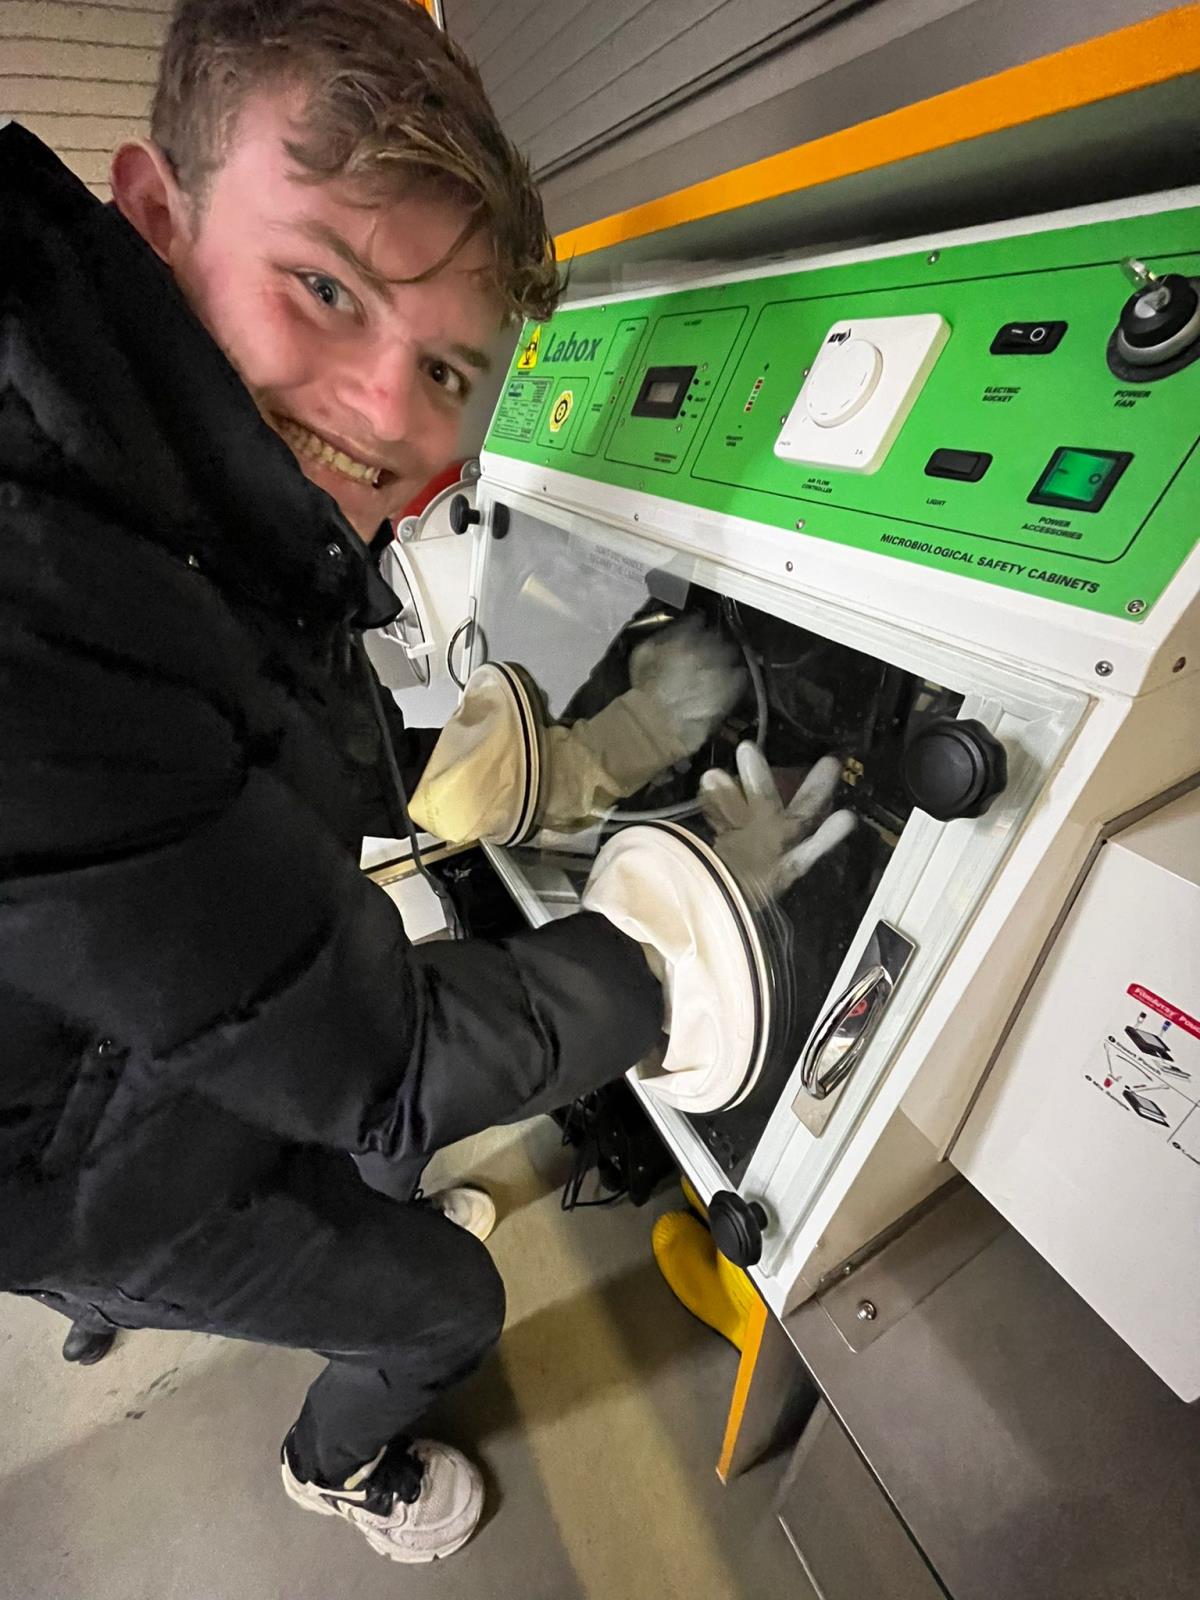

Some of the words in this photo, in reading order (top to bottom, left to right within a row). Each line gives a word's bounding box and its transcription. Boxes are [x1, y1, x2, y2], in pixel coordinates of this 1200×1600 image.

[542, 331, 603, 362] Labox
[984, 386, 1021, 394] ELECTRIC
[1114, 390, 1151, 399] POWER
[1114, 399, 1136, 408] FAN
[926, 498, 947, 506] LIGHT
[1039, 516, 1071, 528] POWER
[880, 533, 974, 564] MICROBIOLOGICAL
[976, 556, 1026, 576] SAFETY
[1027, 568, 1100, 594] CABINETS
